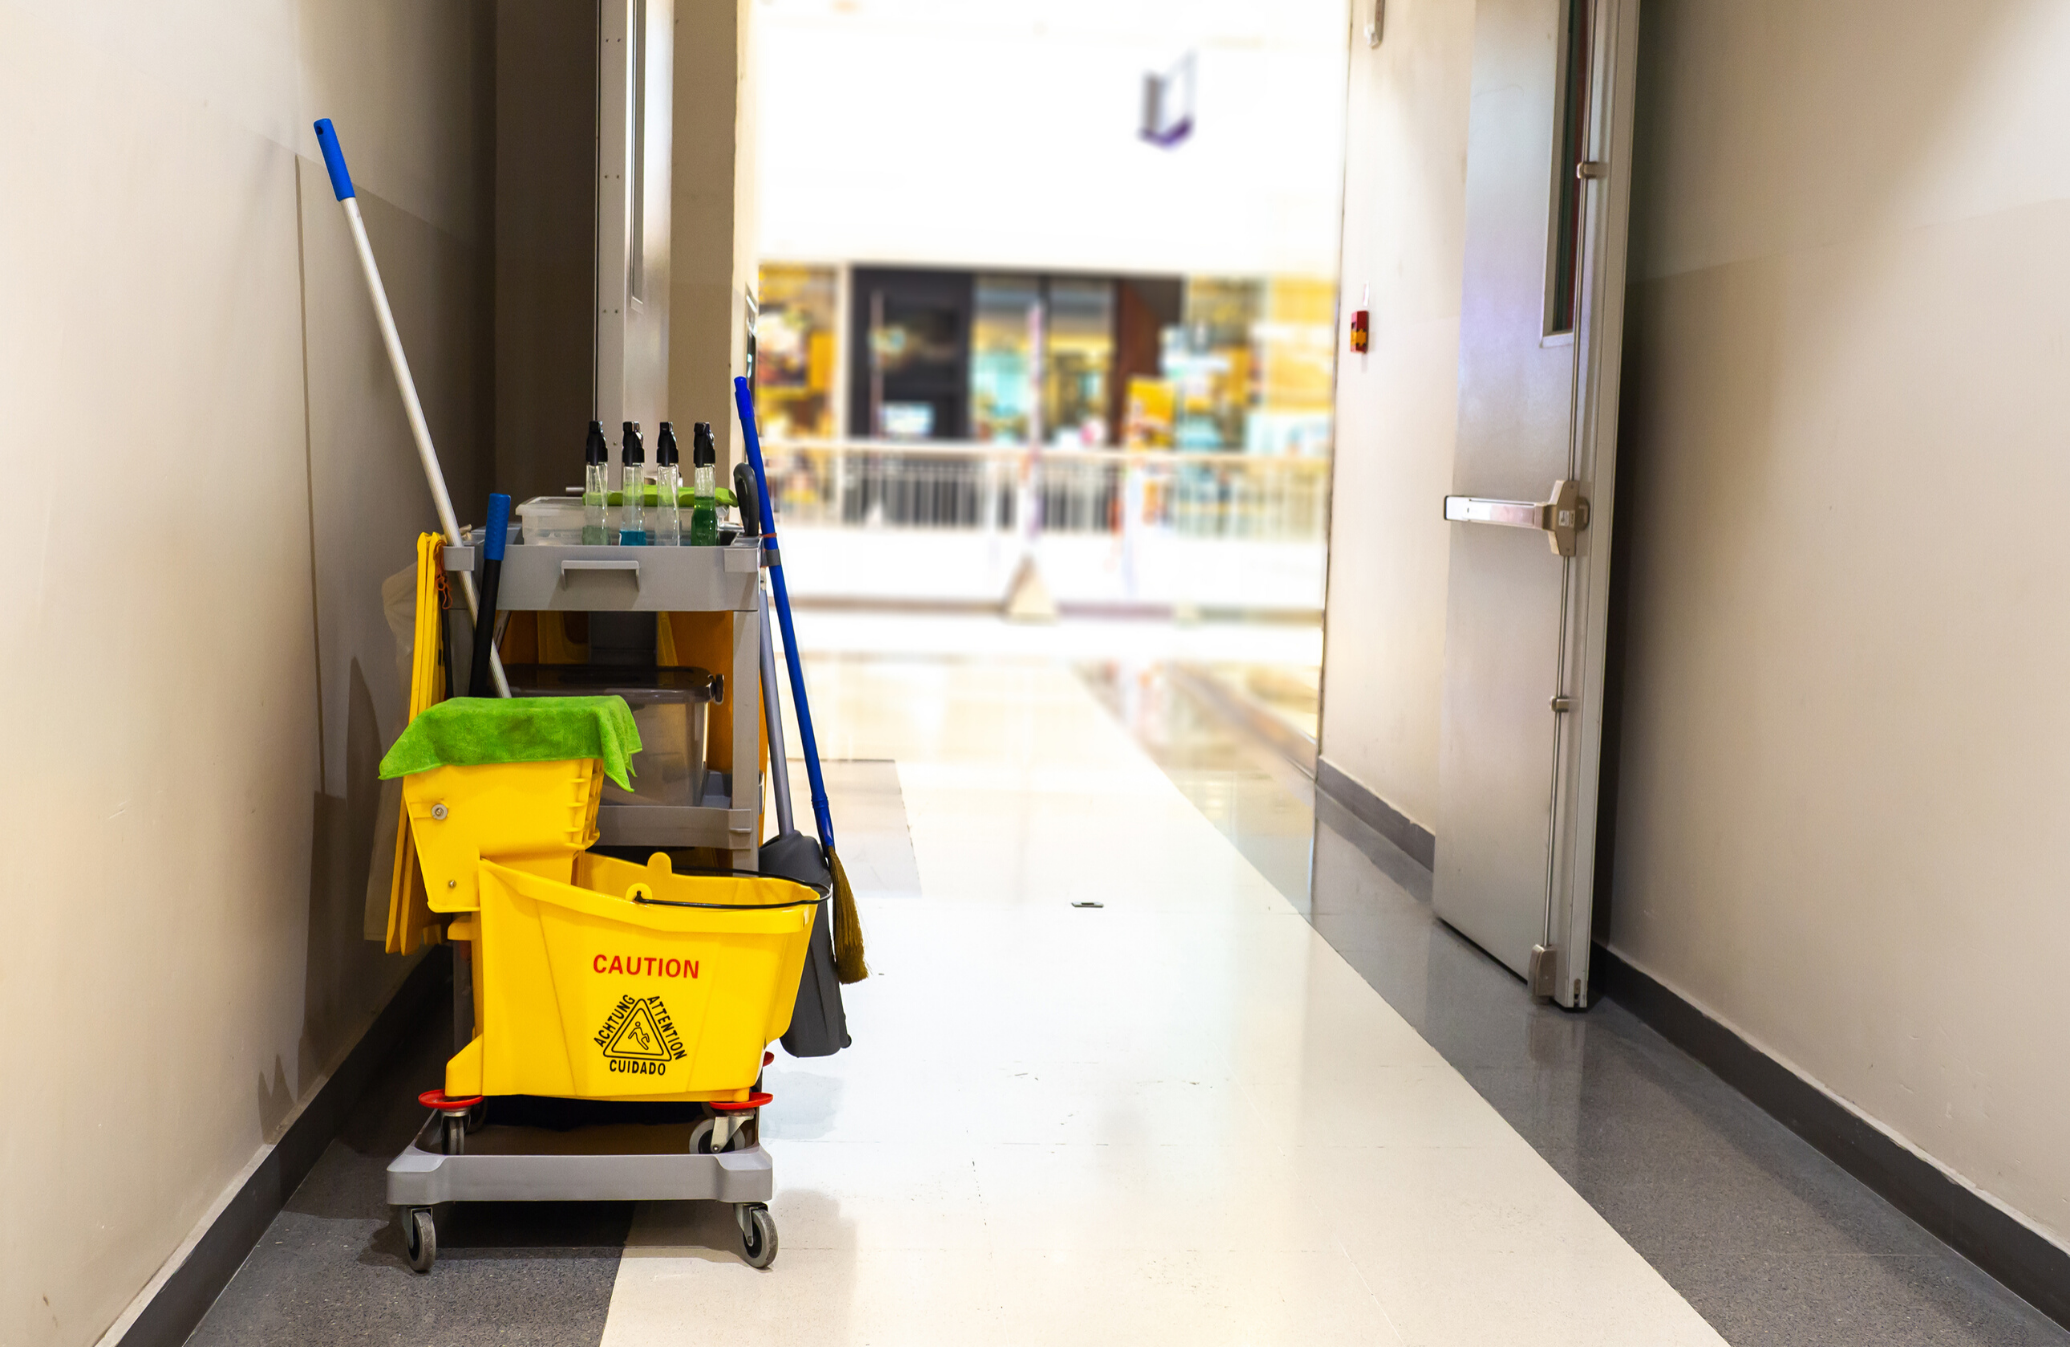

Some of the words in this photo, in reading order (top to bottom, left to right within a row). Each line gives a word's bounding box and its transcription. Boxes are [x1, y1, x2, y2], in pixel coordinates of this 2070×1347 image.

[593, 954, 699, 979] CAUTION
[593, 994, 635, 1047] ACHTUNG
[647, 995, 688, 1060] ATTENTION
[609, 1059, 666, 1076] CUIDADO
